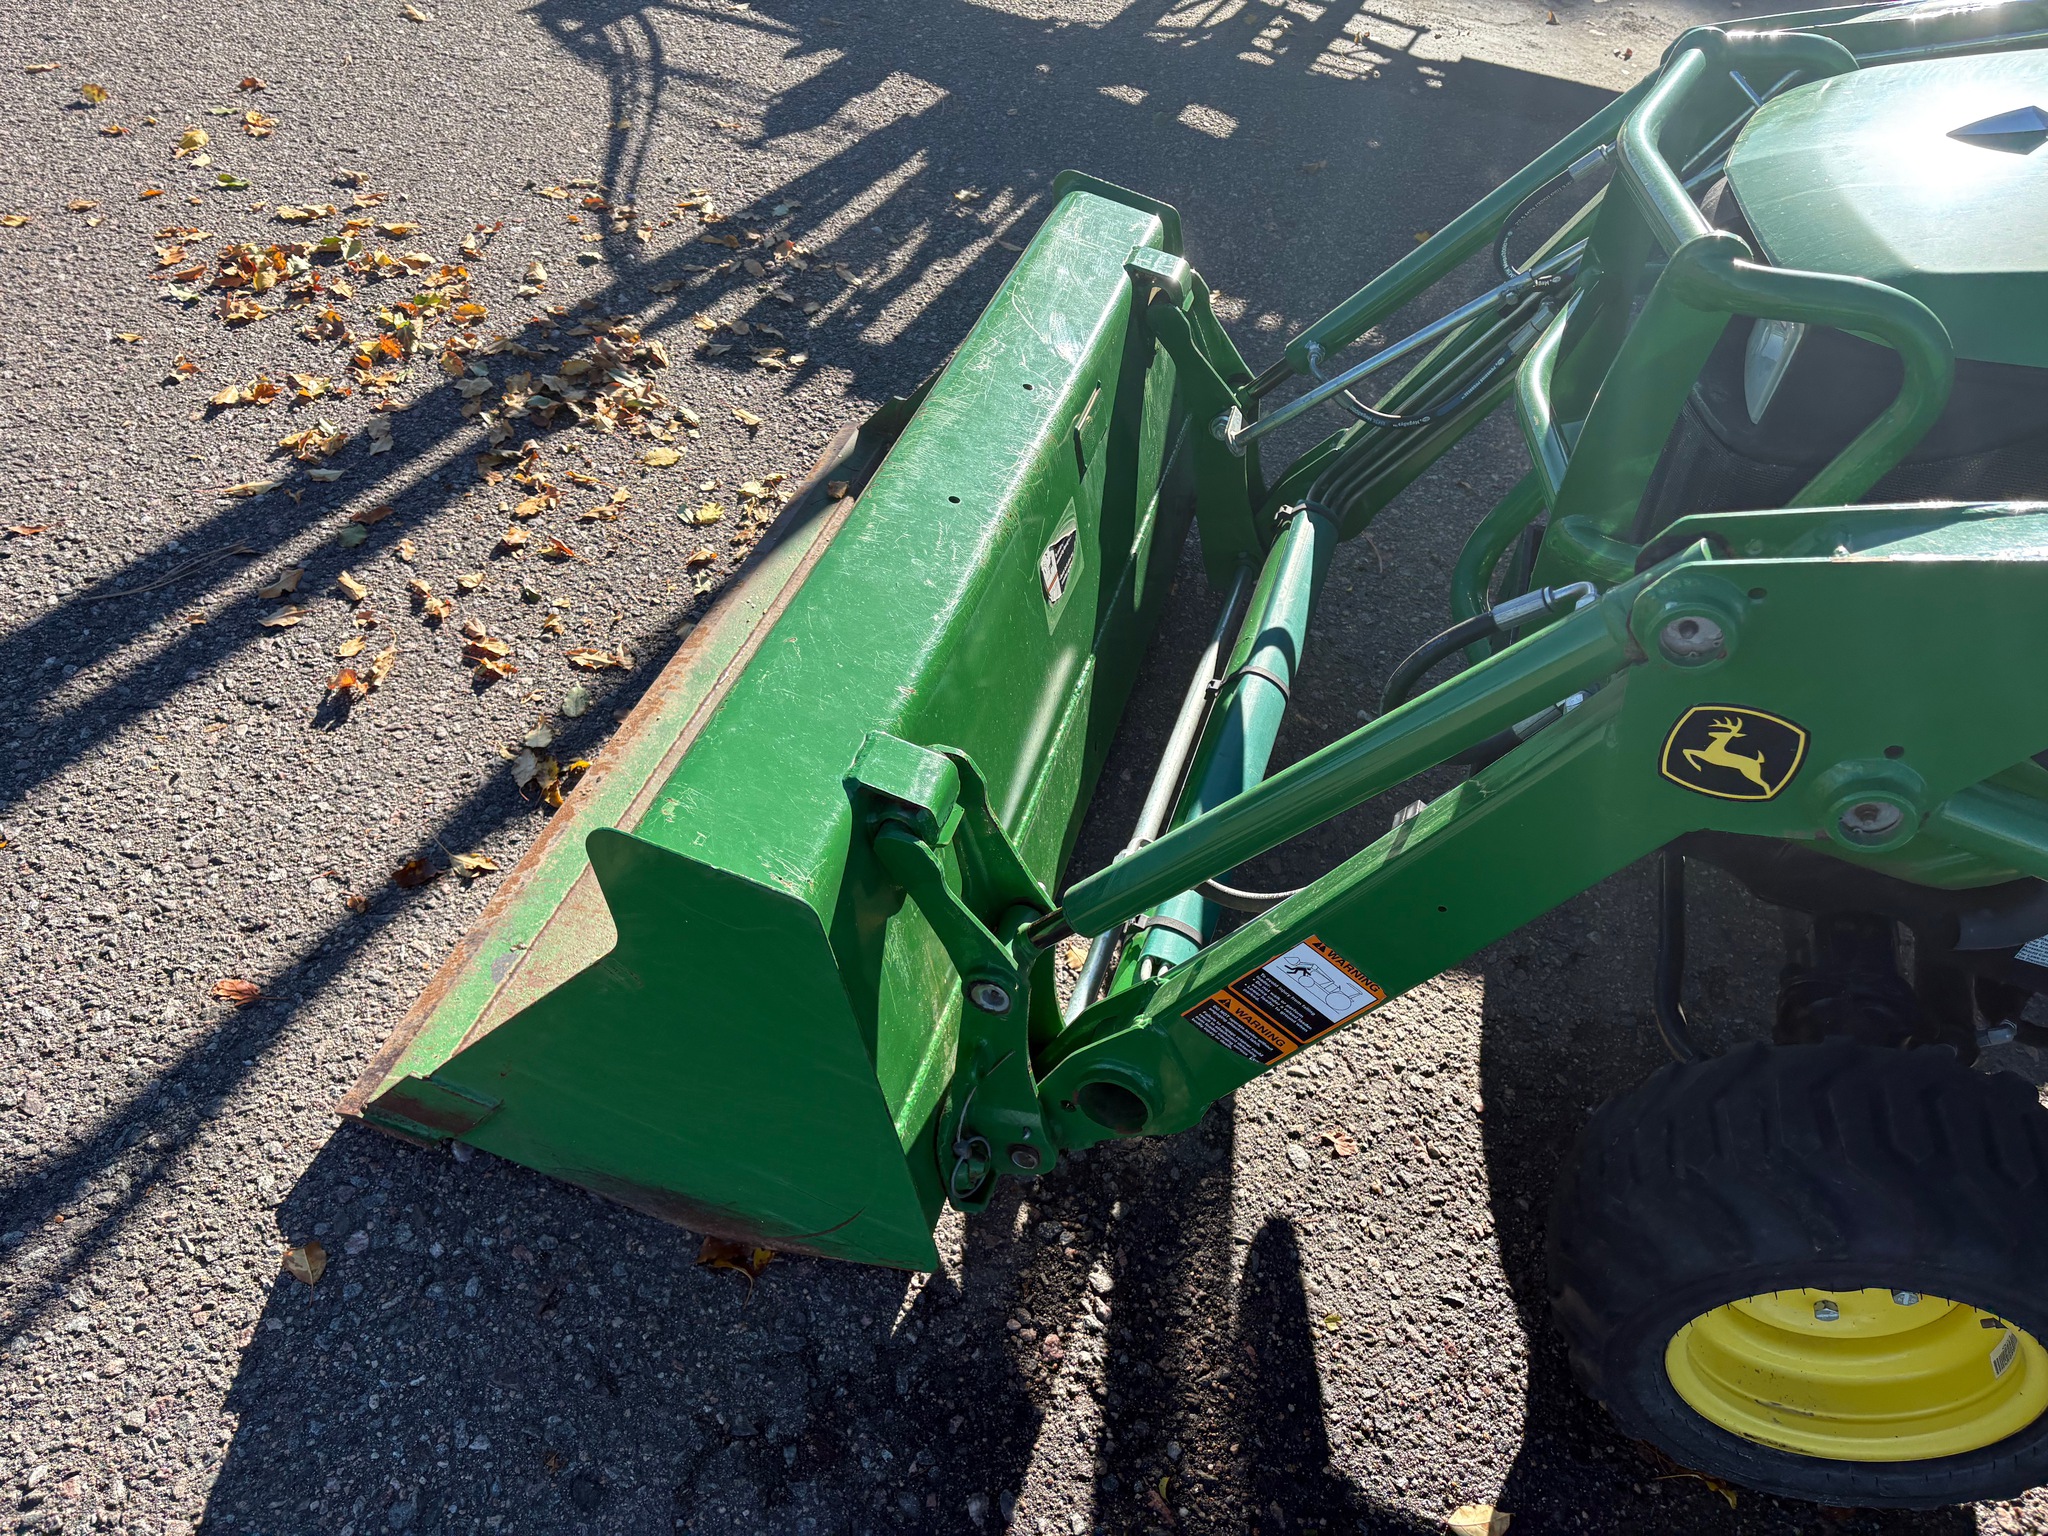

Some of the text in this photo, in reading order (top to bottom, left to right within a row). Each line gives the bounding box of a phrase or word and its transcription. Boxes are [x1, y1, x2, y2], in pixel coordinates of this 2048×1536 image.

[1328, 950, 1380, 992] WARNING
[1247, 986, 1260, 996] Lower
[1280, 1011, 1296, 1023] ground
[1252, 984, 1267, 995] service
[1267, 996, 1280, 1005] under
[1266, 978, 1278, 987] avoid
[1278, 987, 1290, 997] injury
[1291, 996, 1301, 1005] from
[1270, 992, 1280, 1000] walk
[1286, 1005, 1303, 1018] perform
[1235, 1008, 1286, 1047] WARNING
